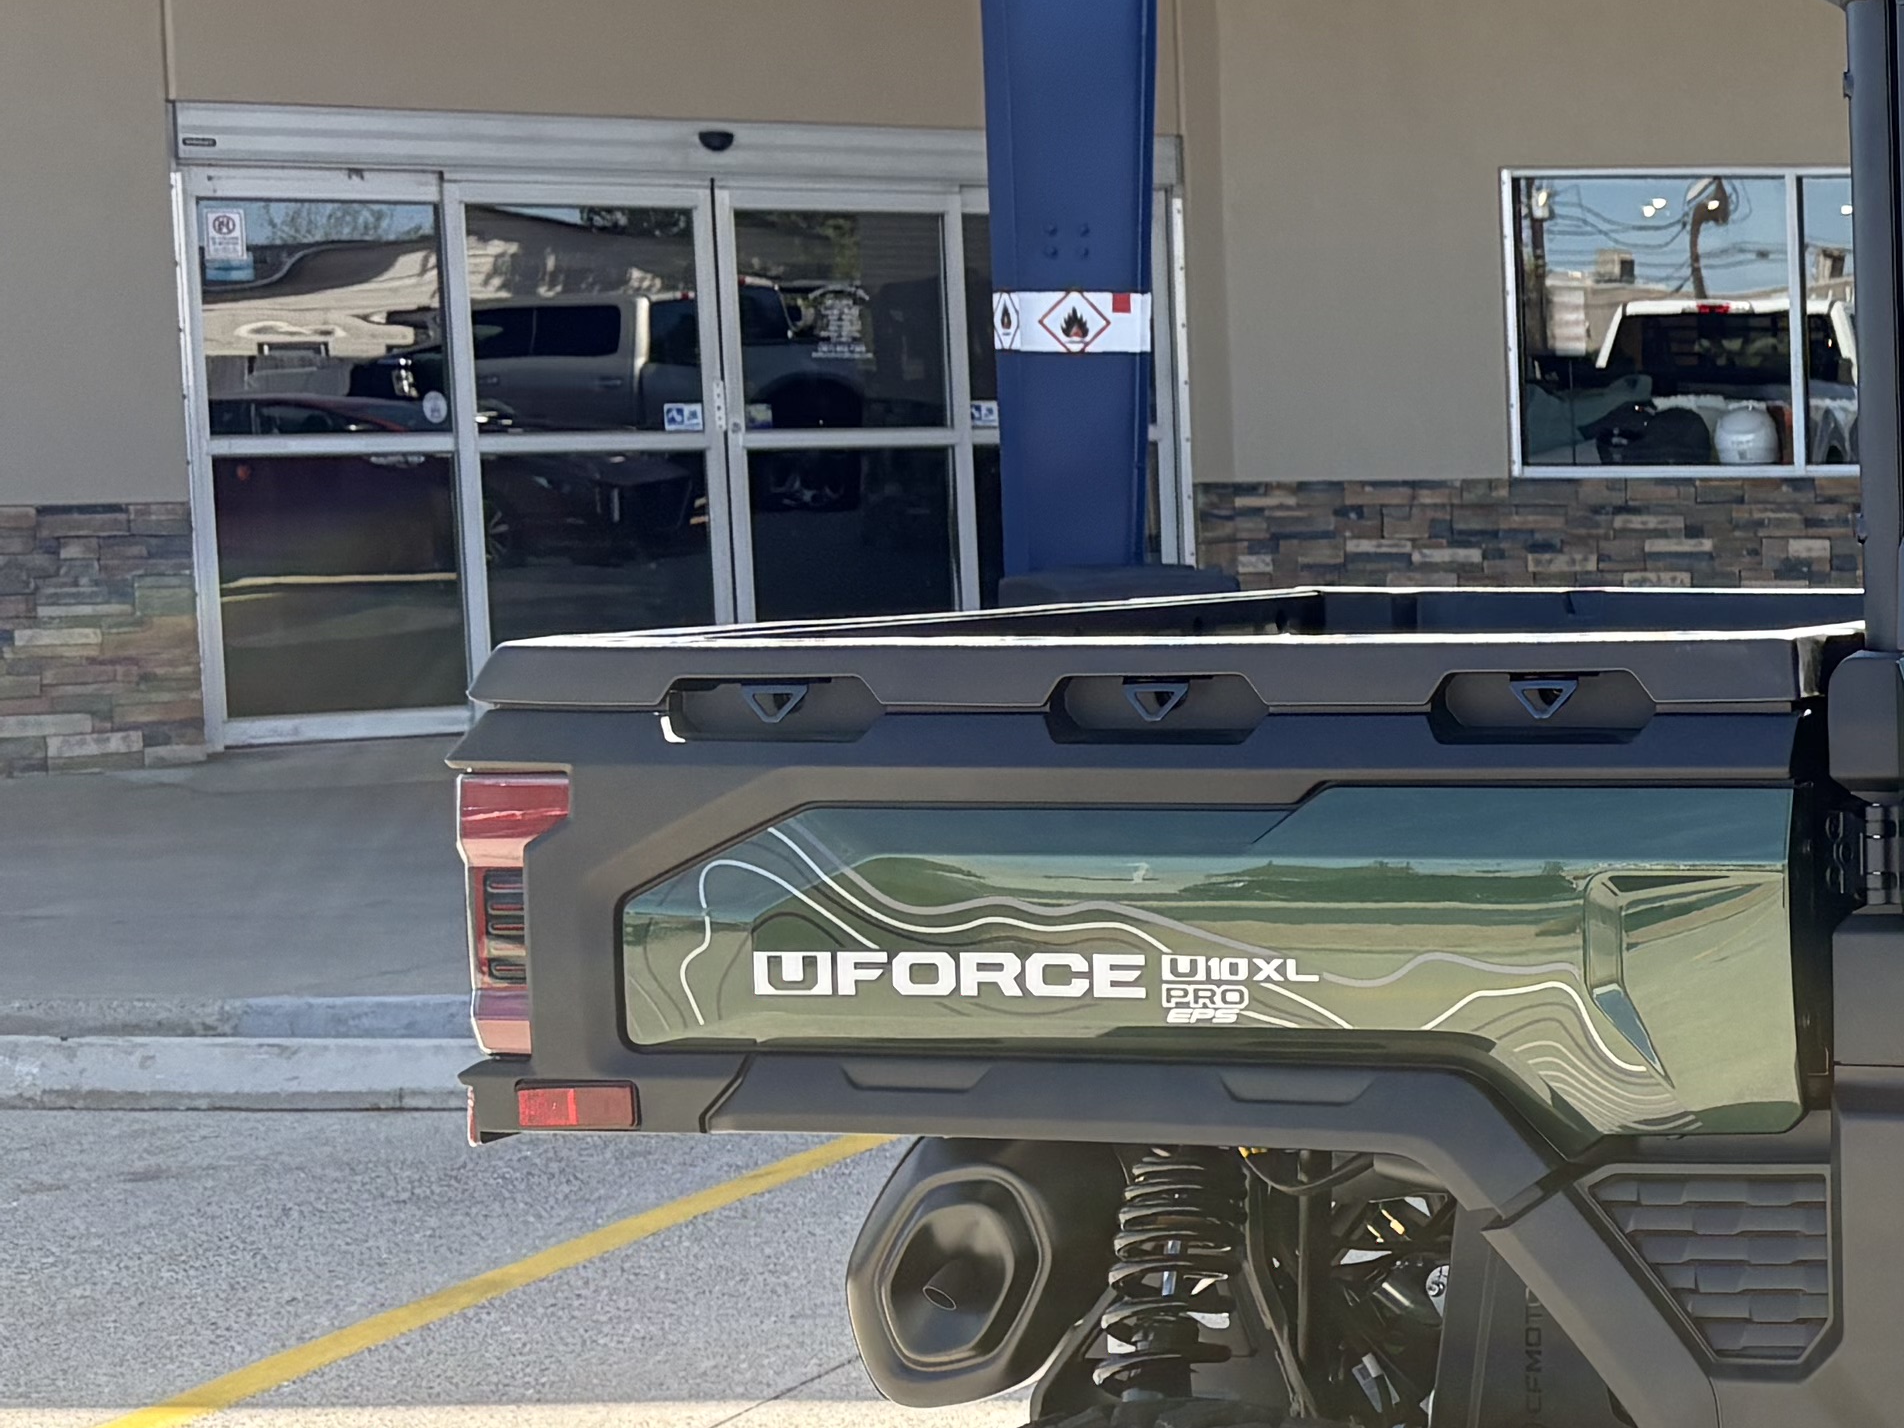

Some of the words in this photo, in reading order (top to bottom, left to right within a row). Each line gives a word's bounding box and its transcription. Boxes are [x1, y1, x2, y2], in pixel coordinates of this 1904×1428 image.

[753, 950, 1147, 999] UFORCE
[1161, 983, 1249, 1009] PRO
[1166, 1008, 1243, 1024] EPS
